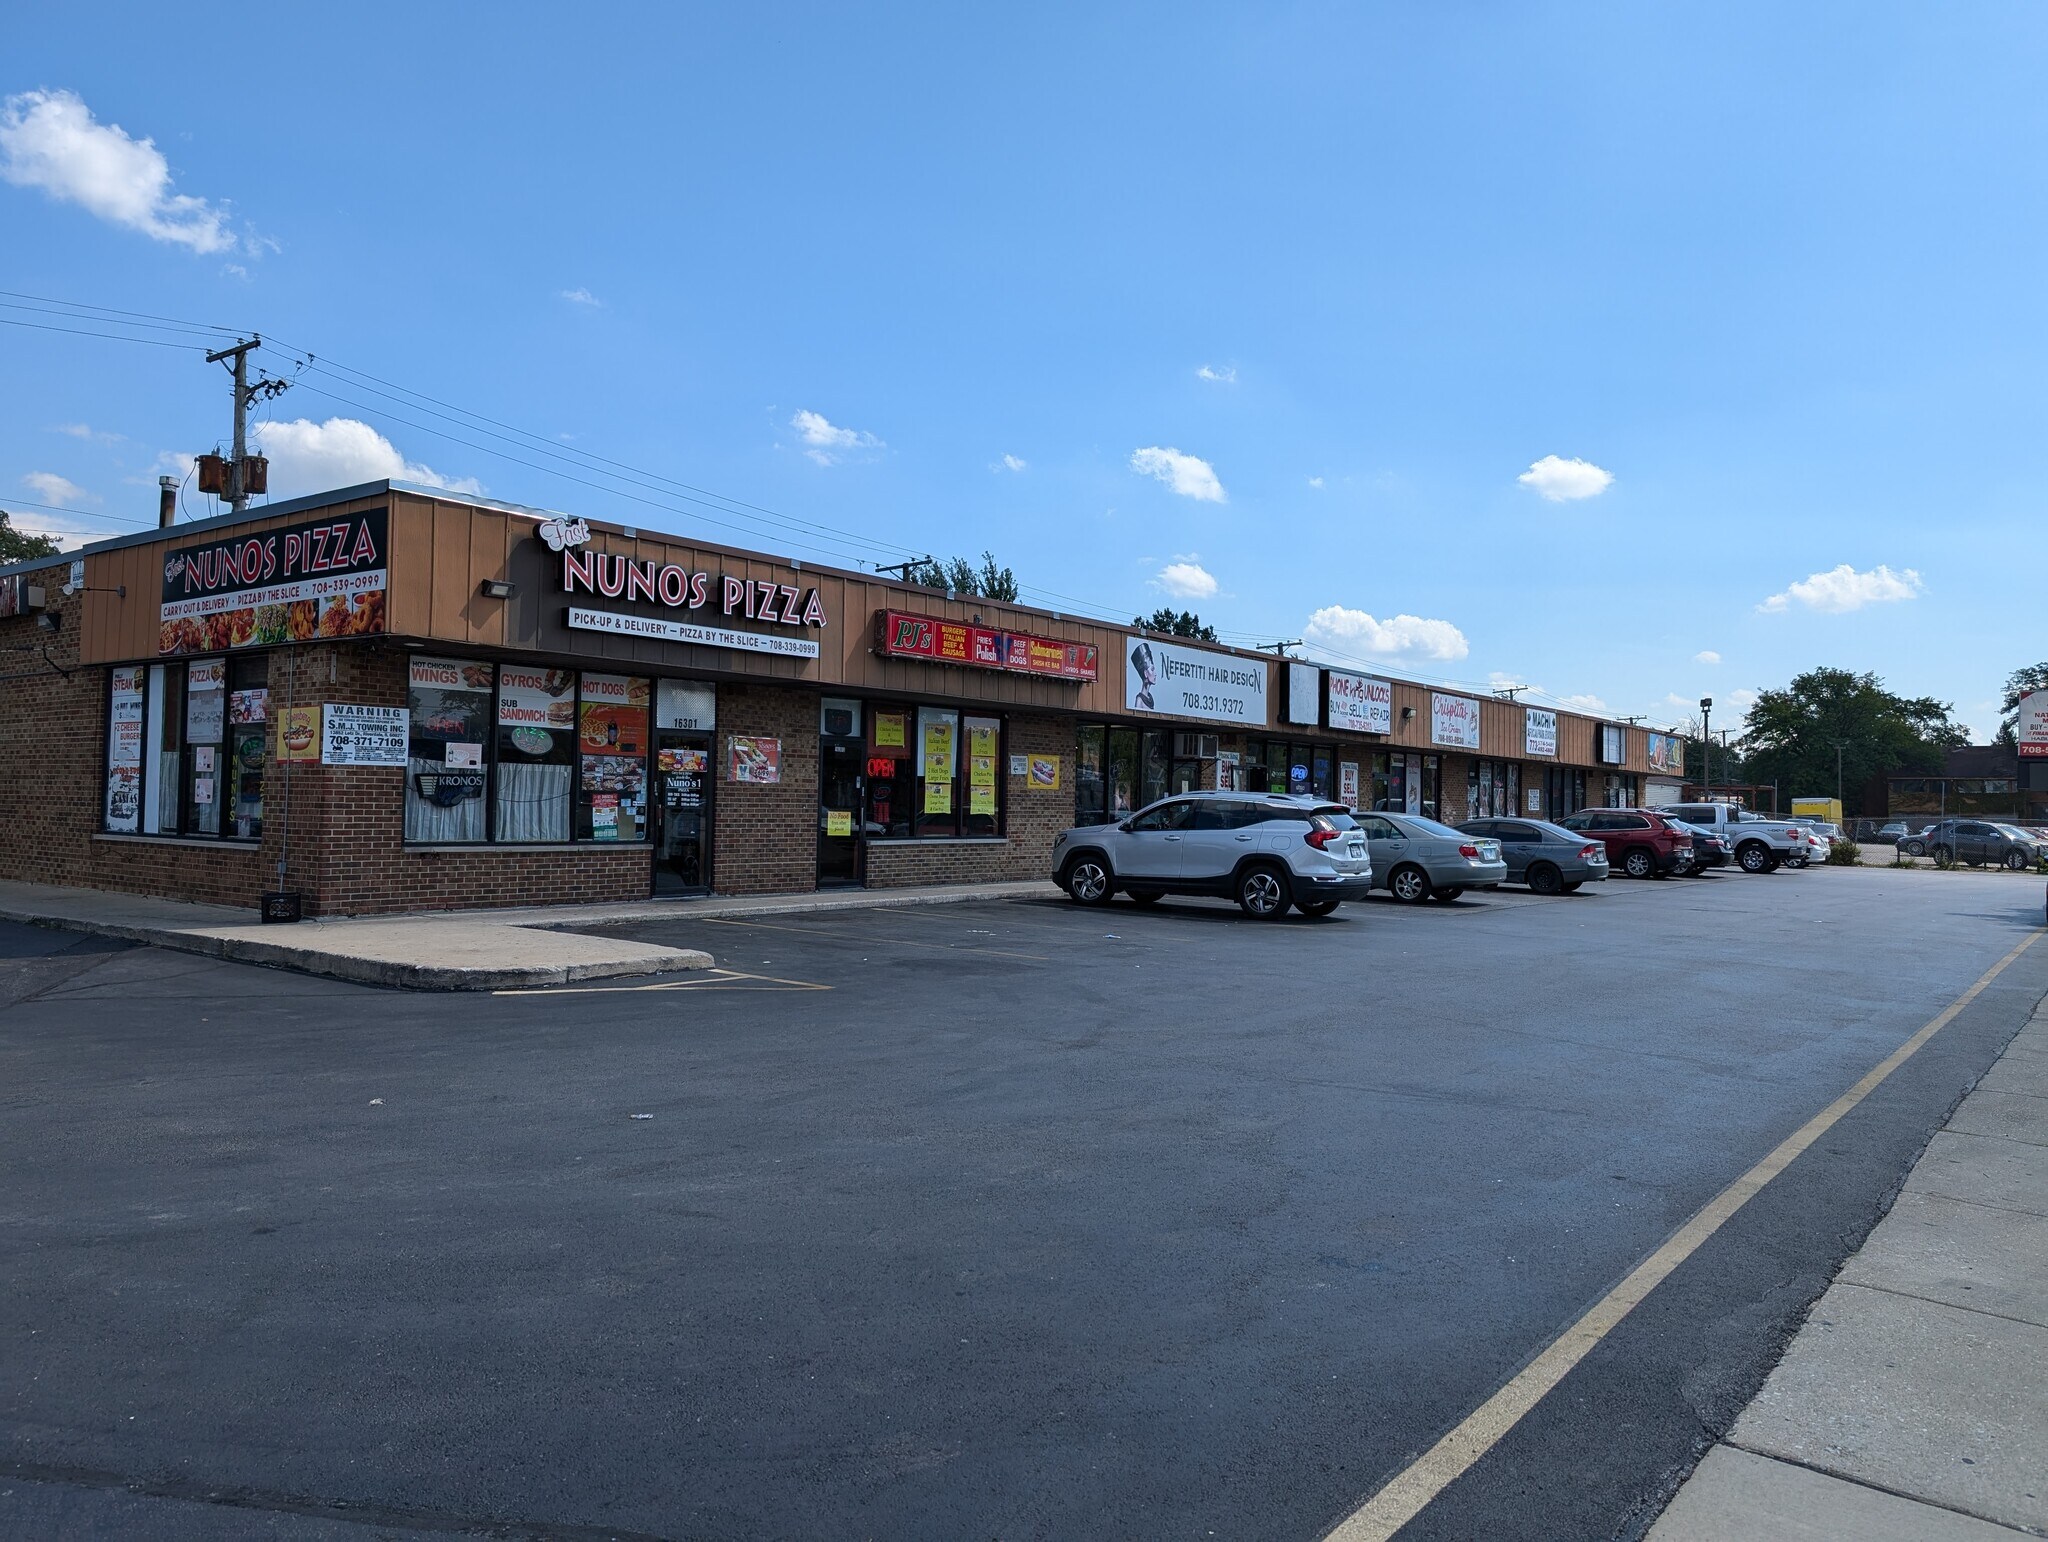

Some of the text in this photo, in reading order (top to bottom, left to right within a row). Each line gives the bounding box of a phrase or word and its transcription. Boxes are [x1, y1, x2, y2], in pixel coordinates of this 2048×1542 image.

[541, 520, 589, 549] Fast
[185, 518, 377, 593] NUNOS PIZZA
[312, 574, 379, 595] 708-339-0999
[564, 548, 828, 628] NUNOS PIZZA
[238, 594, 257, 605] PIZZA
[268, 590, 280, 600] THE
[281, 586, 300, 599] SLICE
[163, 604, 182, 617] CARRY
[183, 602, 196, 614] OUT
[202, 597, 230, 611] DELIVERY
[574, 612, 667, 635] PICK-UP & DELIVERY
[680, 627, 759, 648] PIZZA BY THE SLICE
[893, 620, 932, 649] PJ's
[942, 626, 966, 636] BURGERS
[943, 633, 965, 643] ITALIAN
[977, 636, 992, 645] FRIES
[1014, 640, 1026, 648] BEEF
[769, 640, 816, 654] 708-339-0999
[942, 648, 966, 658] SAUSAGE
[976, 644, 996, 662] Polish
[1014, 648, 1025, 656] HOT
[428, 662, 456, 670] CHICKEN
[1010, 655, 1027, 665] DOGS
[190, 670, 210, 682] PIZZA
[411, 668, 459, 684] WINGS
[501, 673, 543, 689] GYROS
[1208, 666, 1228, 684] HAIR
[114, 678, 134, 691] STEAK
[582, 680, 625, 696] HOT DOGS
[501, 699, 518, 708] SUB
[1182, 692, 1244, 715] 708.331.9372
[1330, 700, 1340, 714] BUY
[333, 706, 400, 717] WARNING
[500, 708, 546, 722] SANDWICH
[1349, 704, 1362, 718] SELL
[1370, 707, 1390, 721] REPAIR
[328, 720, 355, 730] S.M.J.
[357, 723, 388, 732] TOWING
[674, 718, 698, 728] 16301
[329, 736, 404, 747] 708-371-7109
[868, 759, 895, 778] OPEN
[1291, 767, 1308, 780] OPEN
[439, 776, 482, 786] KRONOS
[1220, 775, 1235, 788] SEL
[1344, 770, 1354, 781] BUY
[667, 778, 697, 787] Nuno's
[1344, 783, 1355, 794] SELL
[1342, 796, 1357, 808] TRADE
